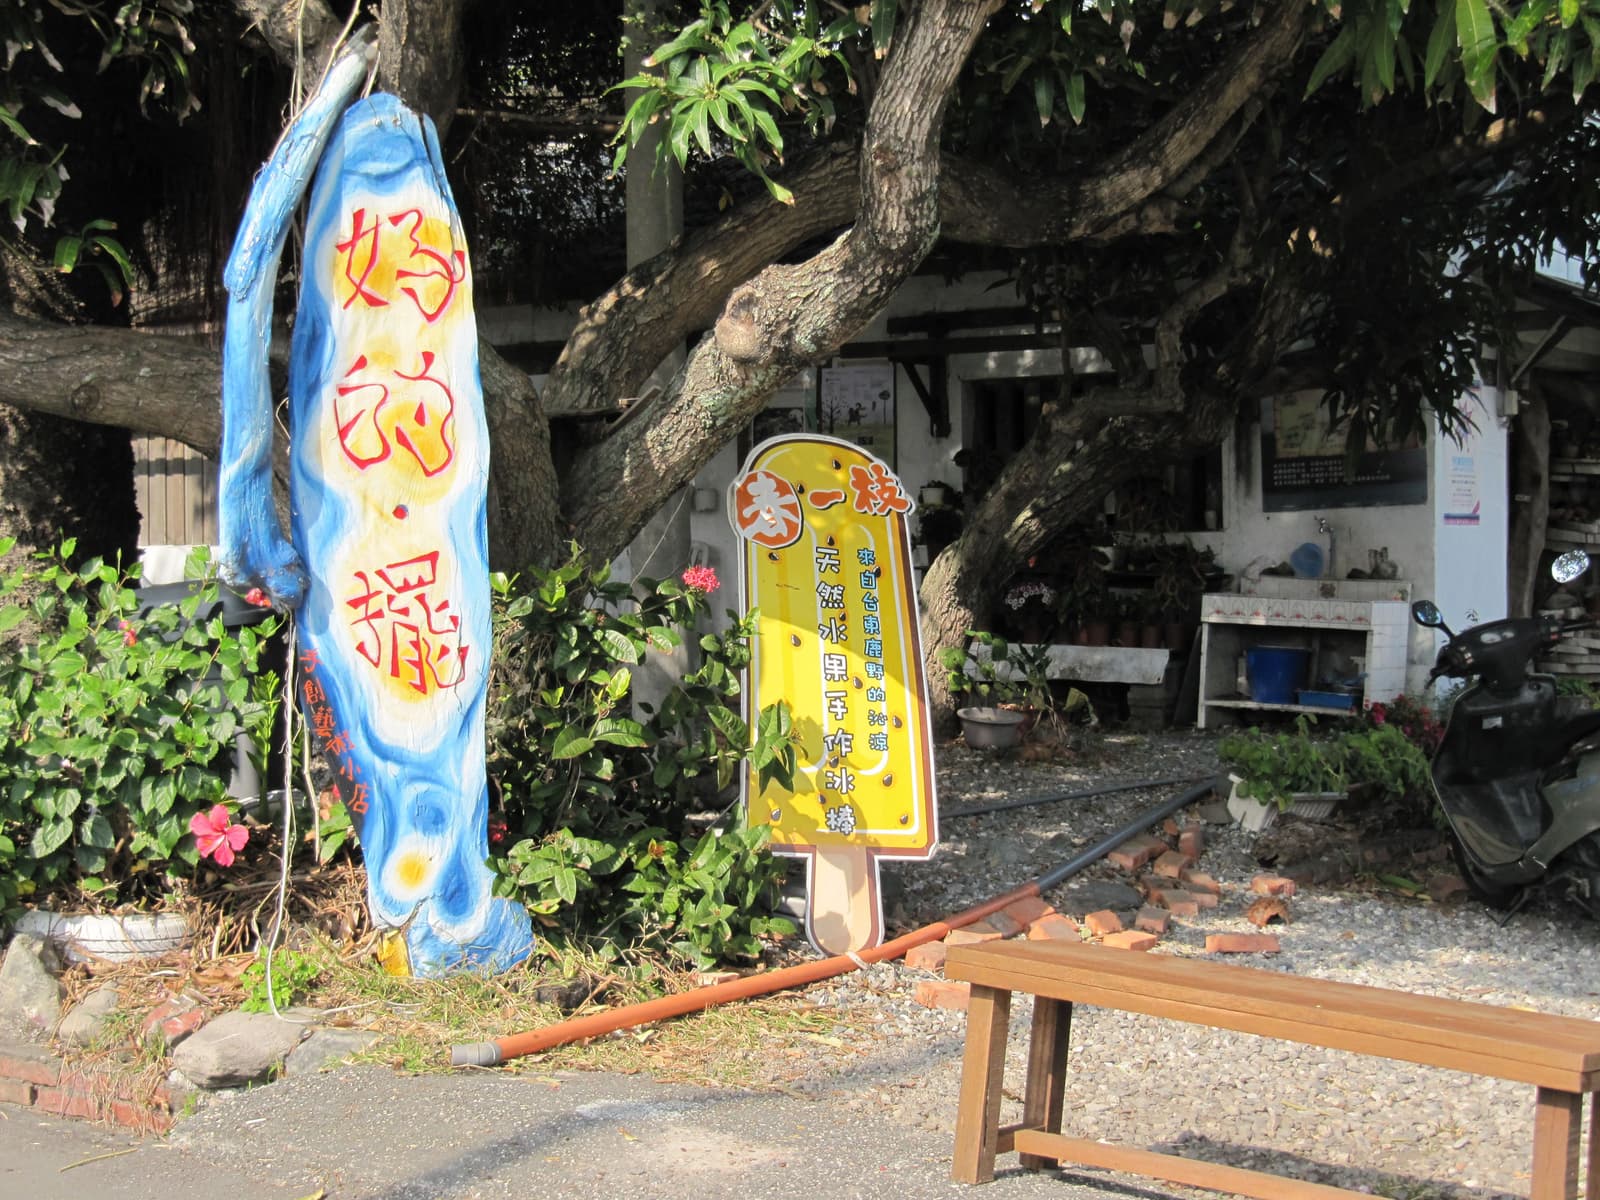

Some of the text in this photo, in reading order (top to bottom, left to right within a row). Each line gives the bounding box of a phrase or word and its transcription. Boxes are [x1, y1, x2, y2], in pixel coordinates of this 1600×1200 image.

[736, 463, 910, 546] 春一枝
[815, 546, 856, 835] 天然水果手作冰棒
[857, 548, 888, 752] 來自台東鹿野的沁涼
